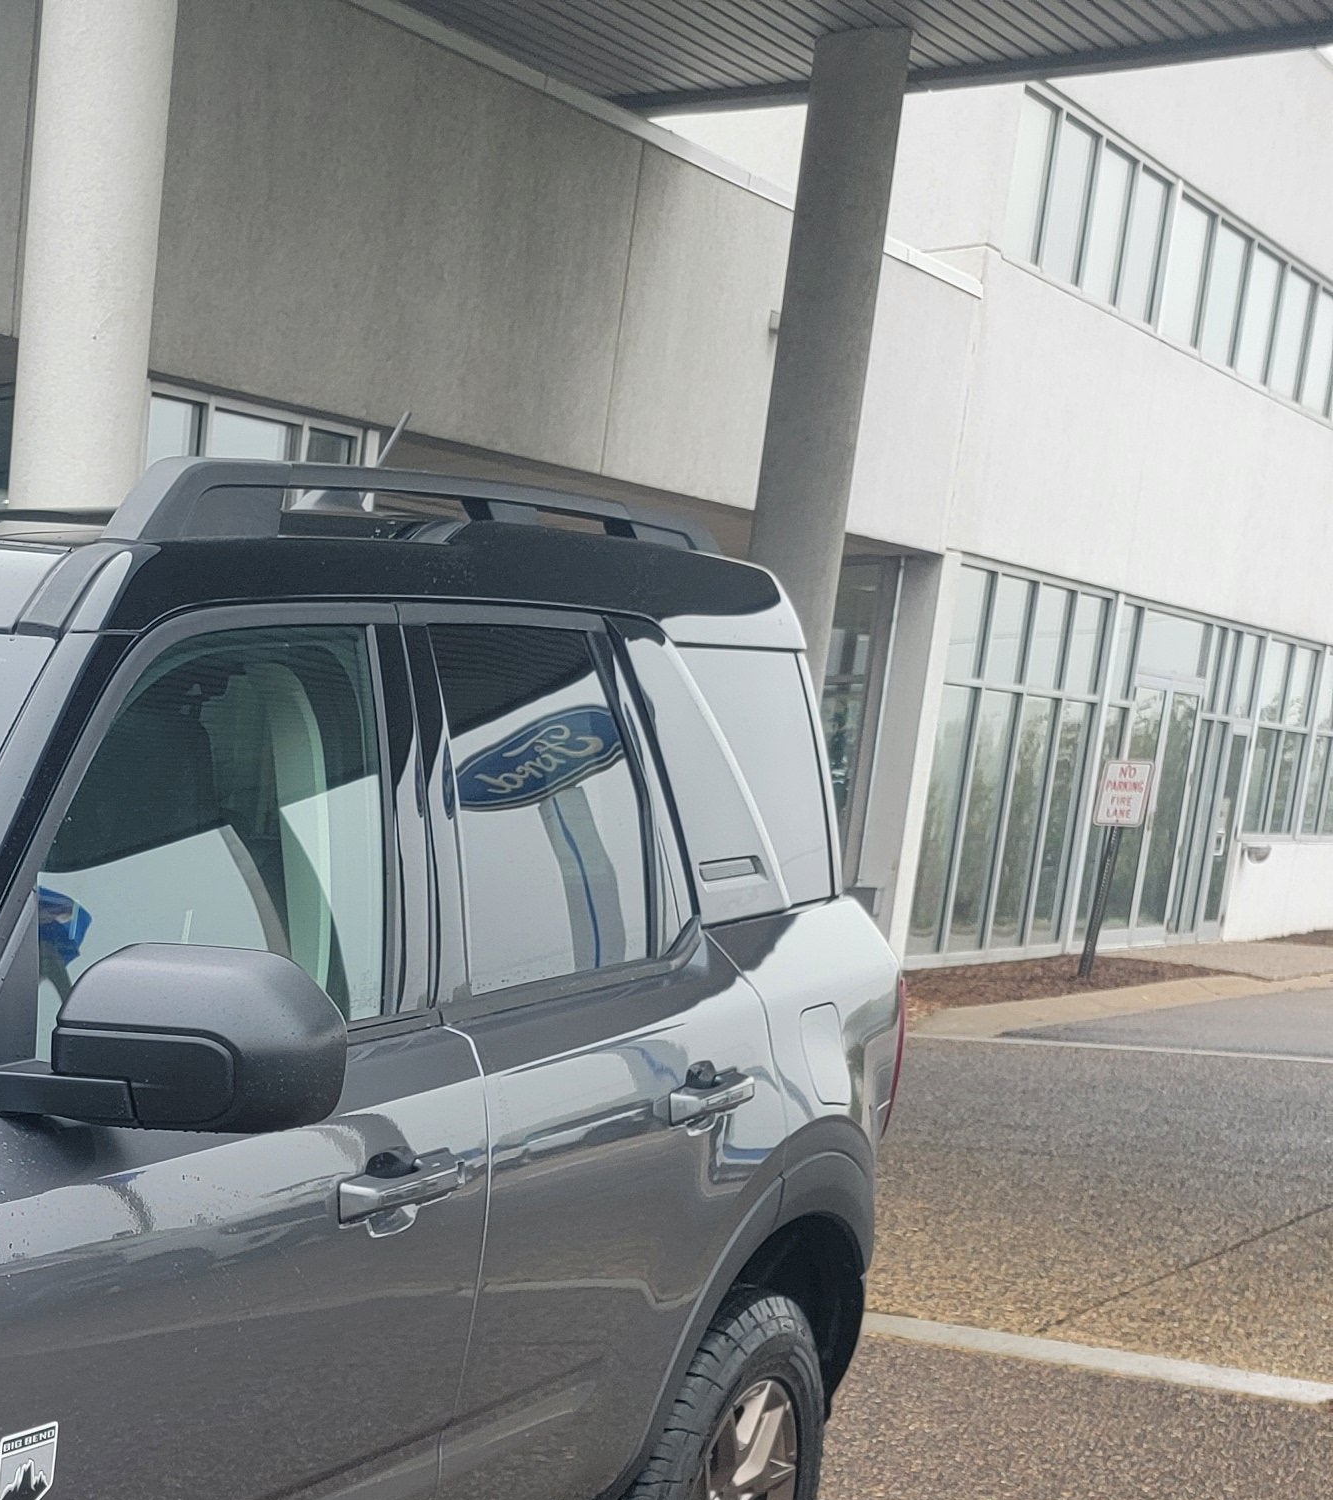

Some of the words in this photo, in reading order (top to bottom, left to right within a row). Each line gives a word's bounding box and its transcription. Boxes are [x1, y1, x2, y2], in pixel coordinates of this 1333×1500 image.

[1119, 766, 1137, 779] NO
[1105, 780, 1145, 793] PARKING
[1110, 796, 1132, 807] FIRE
[1106, 808, 1131, 819] LANE
[3, 1439, 23, 1453] BIG
[24, 1429, 55, 1446] BEND
